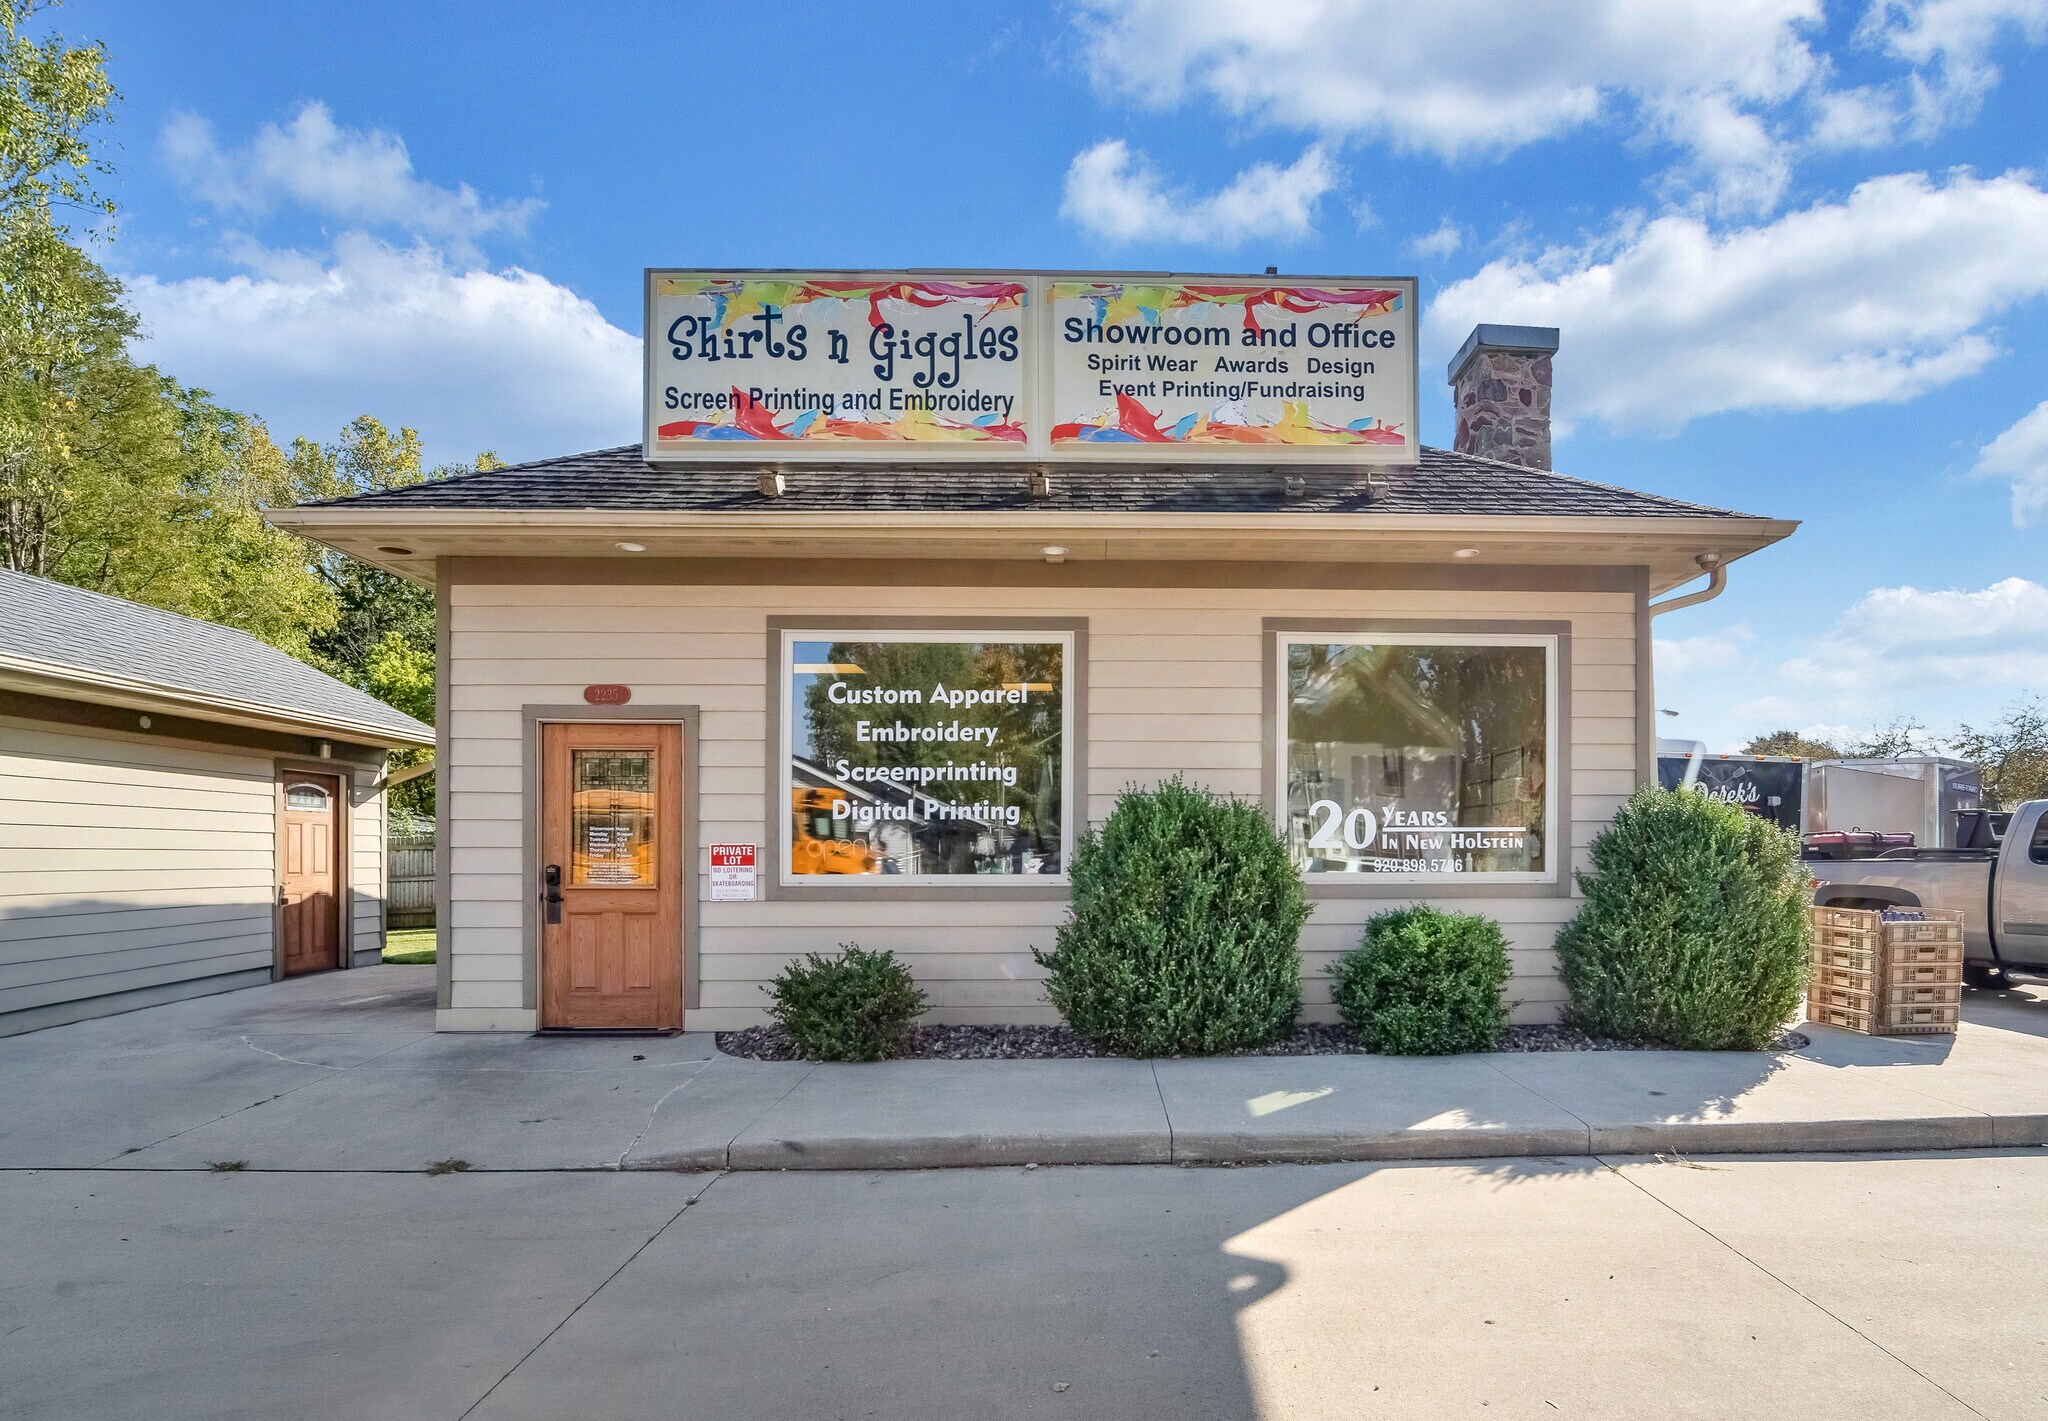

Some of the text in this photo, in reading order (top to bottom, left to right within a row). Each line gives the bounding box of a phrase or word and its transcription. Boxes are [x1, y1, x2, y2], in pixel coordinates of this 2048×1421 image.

[1063, 317, 1396, 349] Showroom and Office
[667, 304, 1019, 389] Shirts n Giggles
[1087, 353, 1375, 378] Spirit Wear Awards Design
[665, 386, 1015, 417] Screen Printing and Embroidery
[1099, 380, 1365, 402] Event Printing/Fundraising
[594, 689, 618, 700] 2235
[827, 682, 1028, 709] Custom Apparel
[856, 720, 998, 747] Embroidery
[835, 760, 1017, 787] Screenprinting
[832, 799, 1020, 825] Digital Printing
[1308, 799, 1377, 850] 20
[1382, 806, 1447, 827] YEARS
[713, 847, 752, 855] PRIVATE
[1382, 834, 1398, 849] IN
[1406, 834, 1443, 850] NEW
[723, 856, 742, 865] LOT
